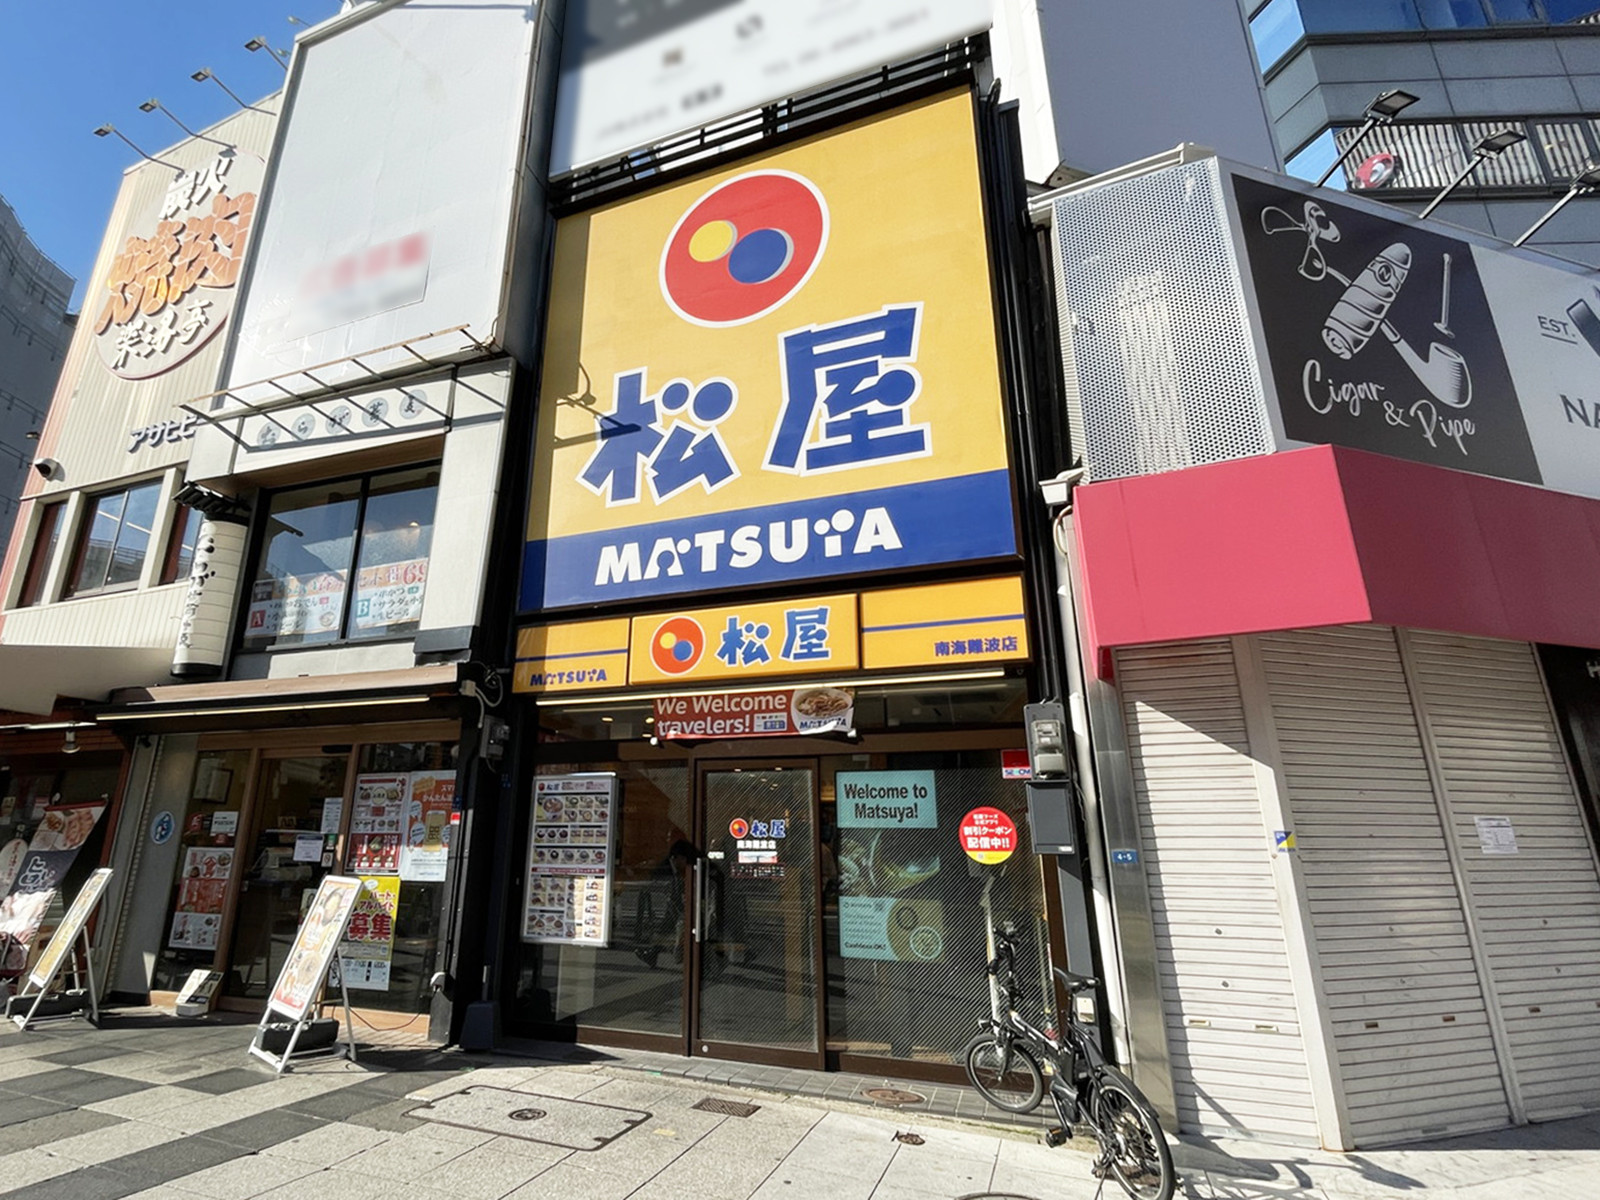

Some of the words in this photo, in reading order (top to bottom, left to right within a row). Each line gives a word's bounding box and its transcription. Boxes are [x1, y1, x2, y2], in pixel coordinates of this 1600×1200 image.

[158, 156, 232, 221] 炭火
[94, 192, 257, 336] 焼肉
[1537, 315, 1577, 338] EST.
[575, 301, 933, 507] 松屋
[1302, 359, 1386, 417] Cigar
[1384, 402, 1410, 428] &
[1410, 399, 1476, 456] Pipe
[593, 506, 903, 586] MATSUYA
[358, 600, 368, 616] B
[716, 605, 831, 666] 松屋
[934, 635, 1018, 657] 南海難波店
[529, 668, 607, 687] MATSUYA
[656, 698, 687, 715] We
[692, 694, 787, 714] Welcome
[657, 714, 750, 737] travelers!
[844, 783, 908, 799] Welcome
[912, 784, 928, 799] to
[854, 802, 919, 822] Matsuya!
[750, 819, 786, 838] 松屋
[963, 826, 1012, 836] 割引クーポン
[347, 911, 393, 941] 募集
